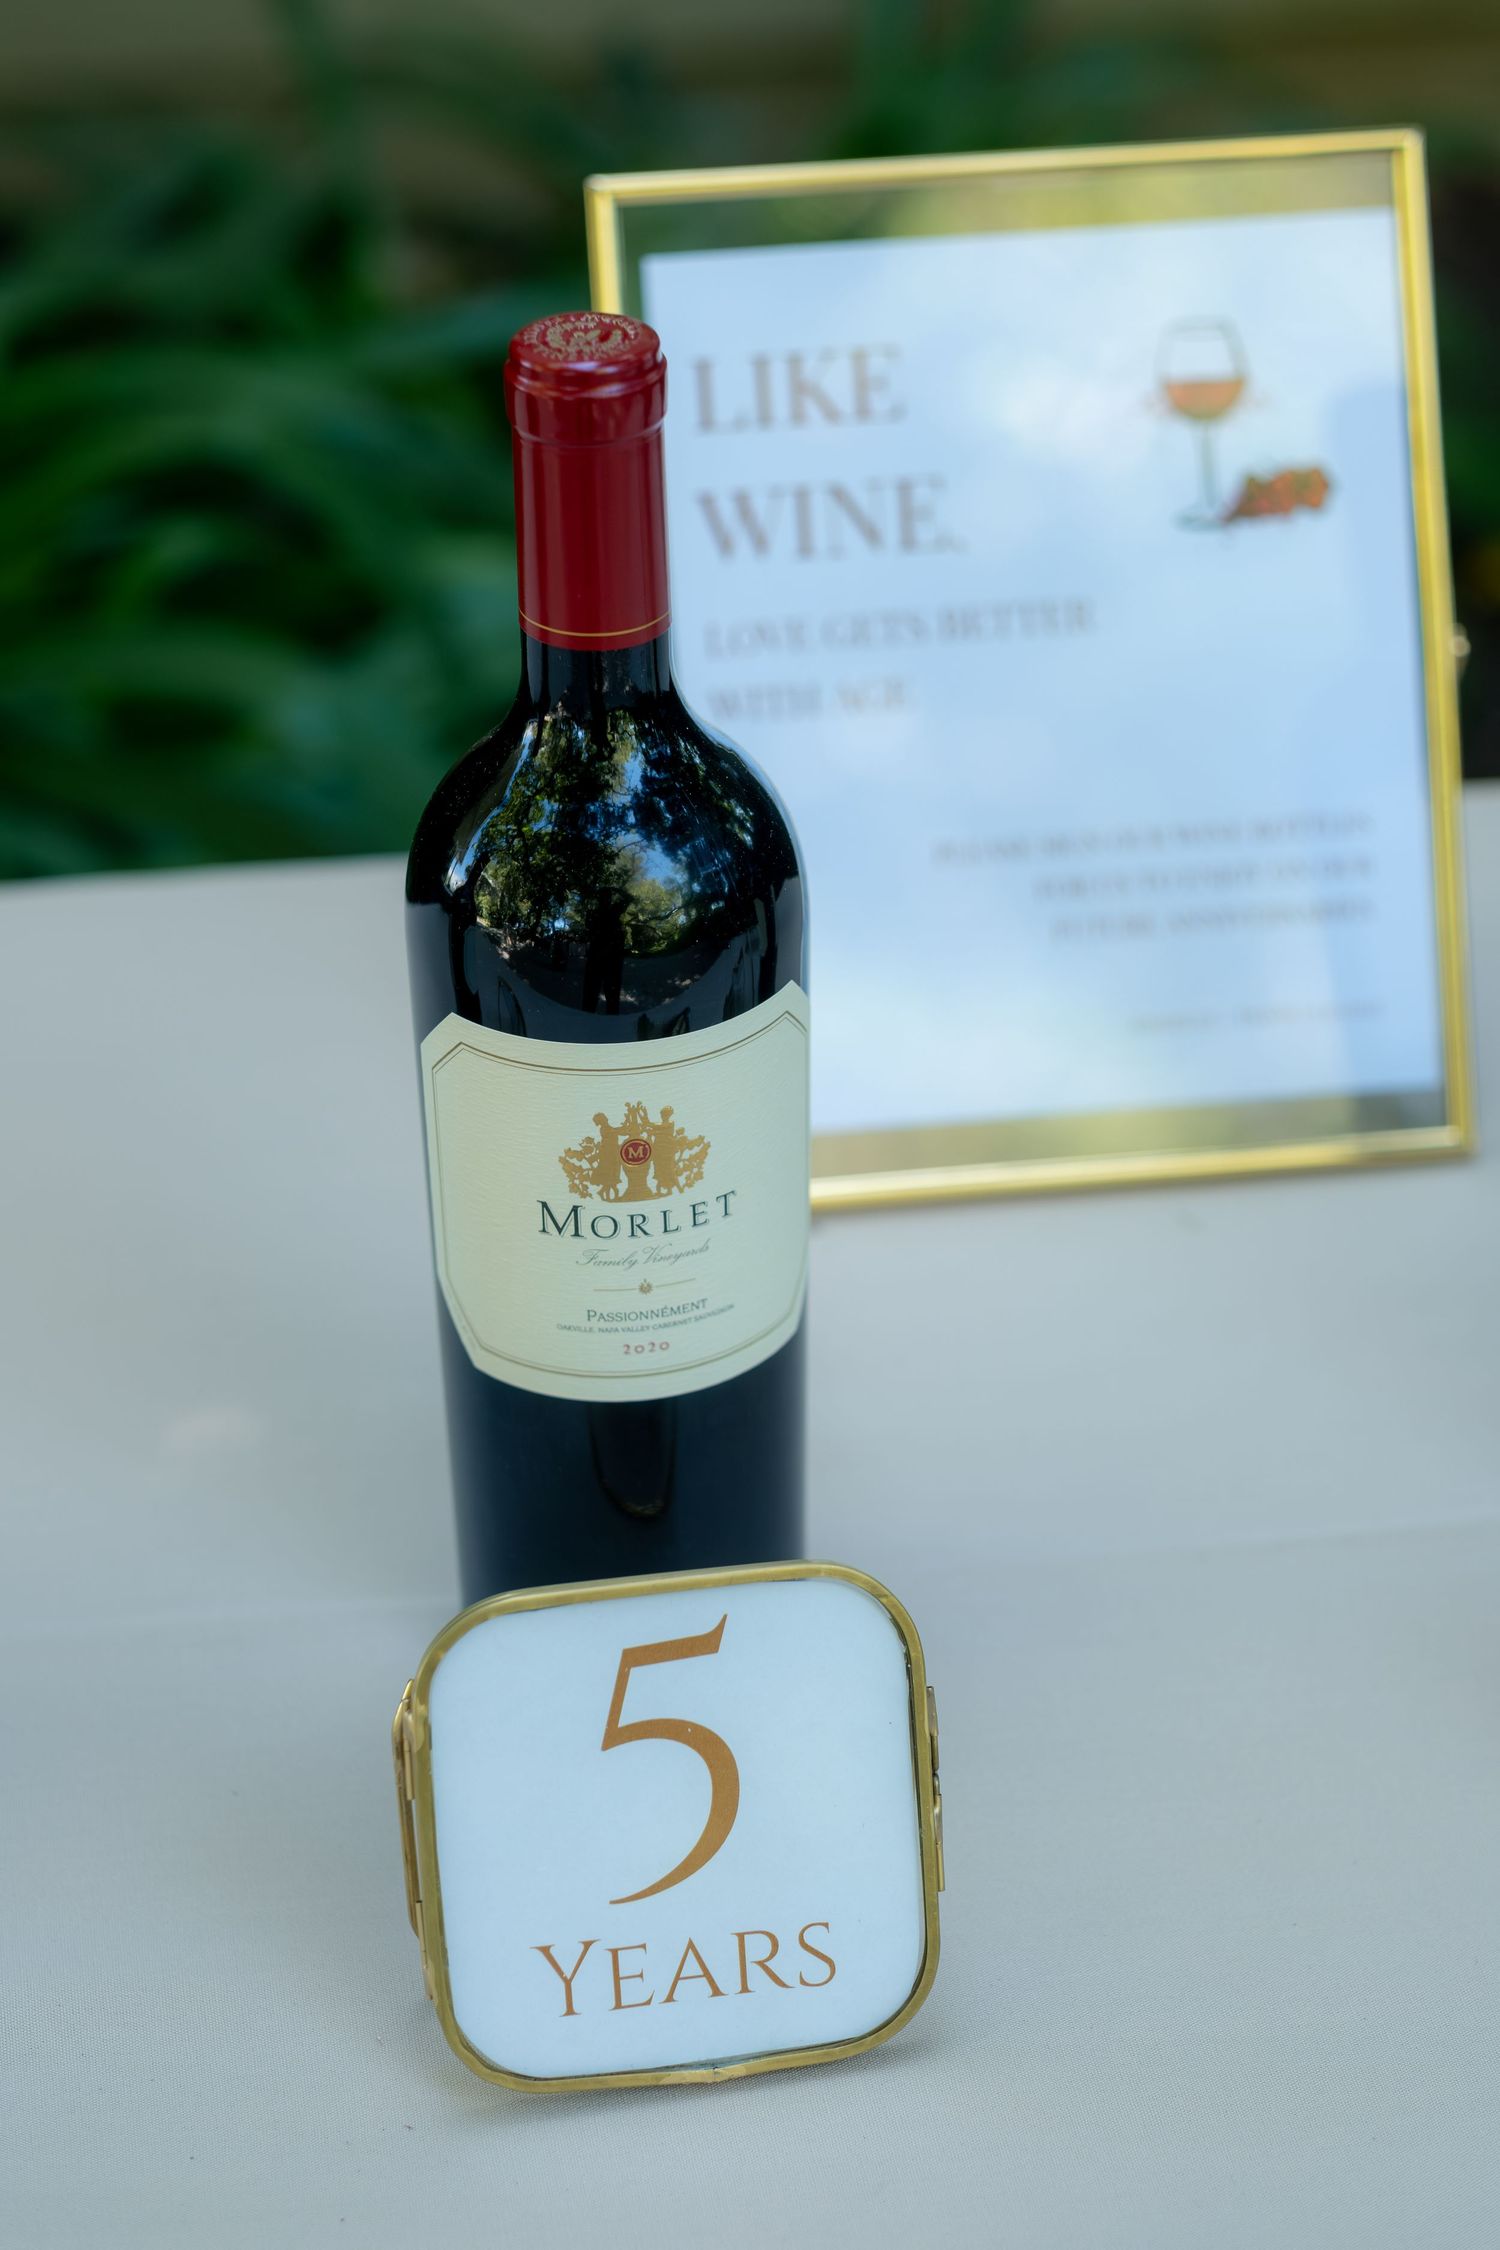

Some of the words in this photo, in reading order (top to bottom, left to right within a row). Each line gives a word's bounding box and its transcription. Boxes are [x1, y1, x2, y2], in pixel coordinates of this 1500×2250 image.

[692, 344, 909, 434] LIKE
[627, 1145, 645, 1160] M
[536, 1190, 740, 1240] MORLET
[575, 1248, 639, 1271] Family
[642, 1238, 711, 1266] Vineyards
[623, 1341, 671, 1356] 2020
[601, 1613, 740, 1905] 5
[530, 1921, 838, 2018] YEARS
